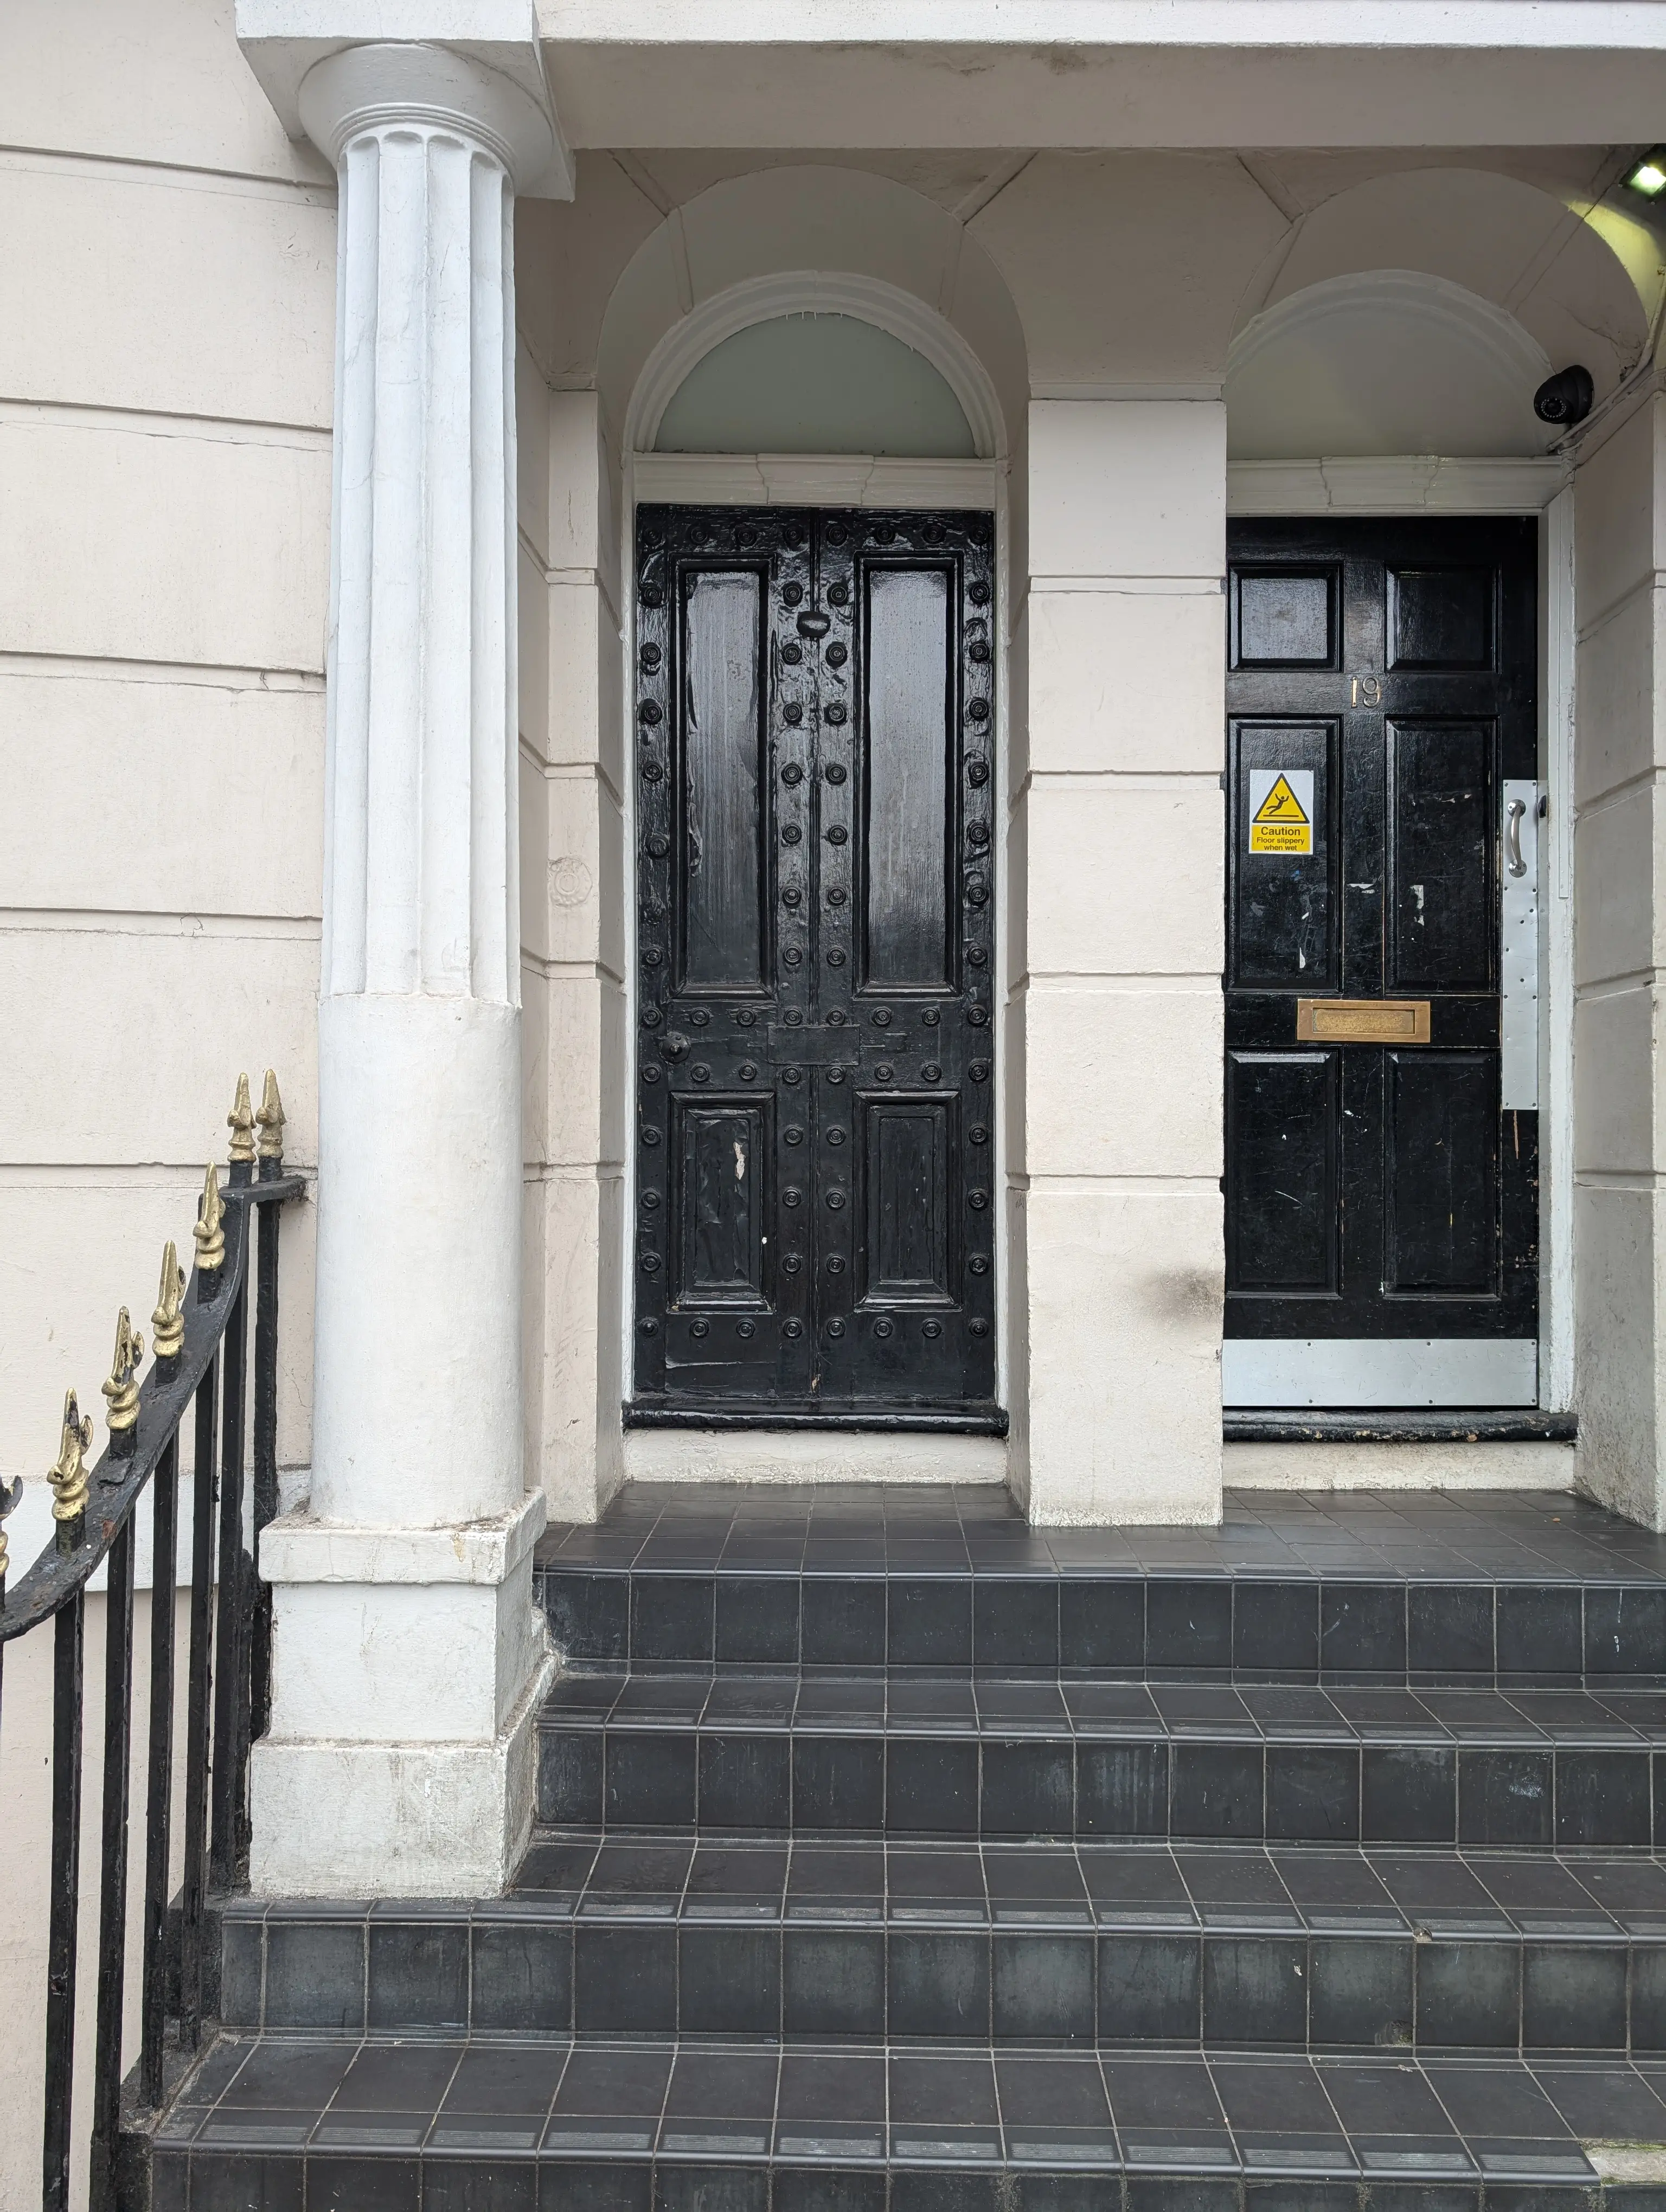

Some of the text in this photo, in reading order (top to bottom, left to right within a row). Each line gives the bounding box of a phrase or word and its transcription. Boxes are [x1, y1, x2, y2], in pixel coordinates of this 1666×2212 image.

[1351, 676, 1382, 708] 19
[1261, 826, 1300, 835] Caution
[1277, 837, 1305, 845] slippery
